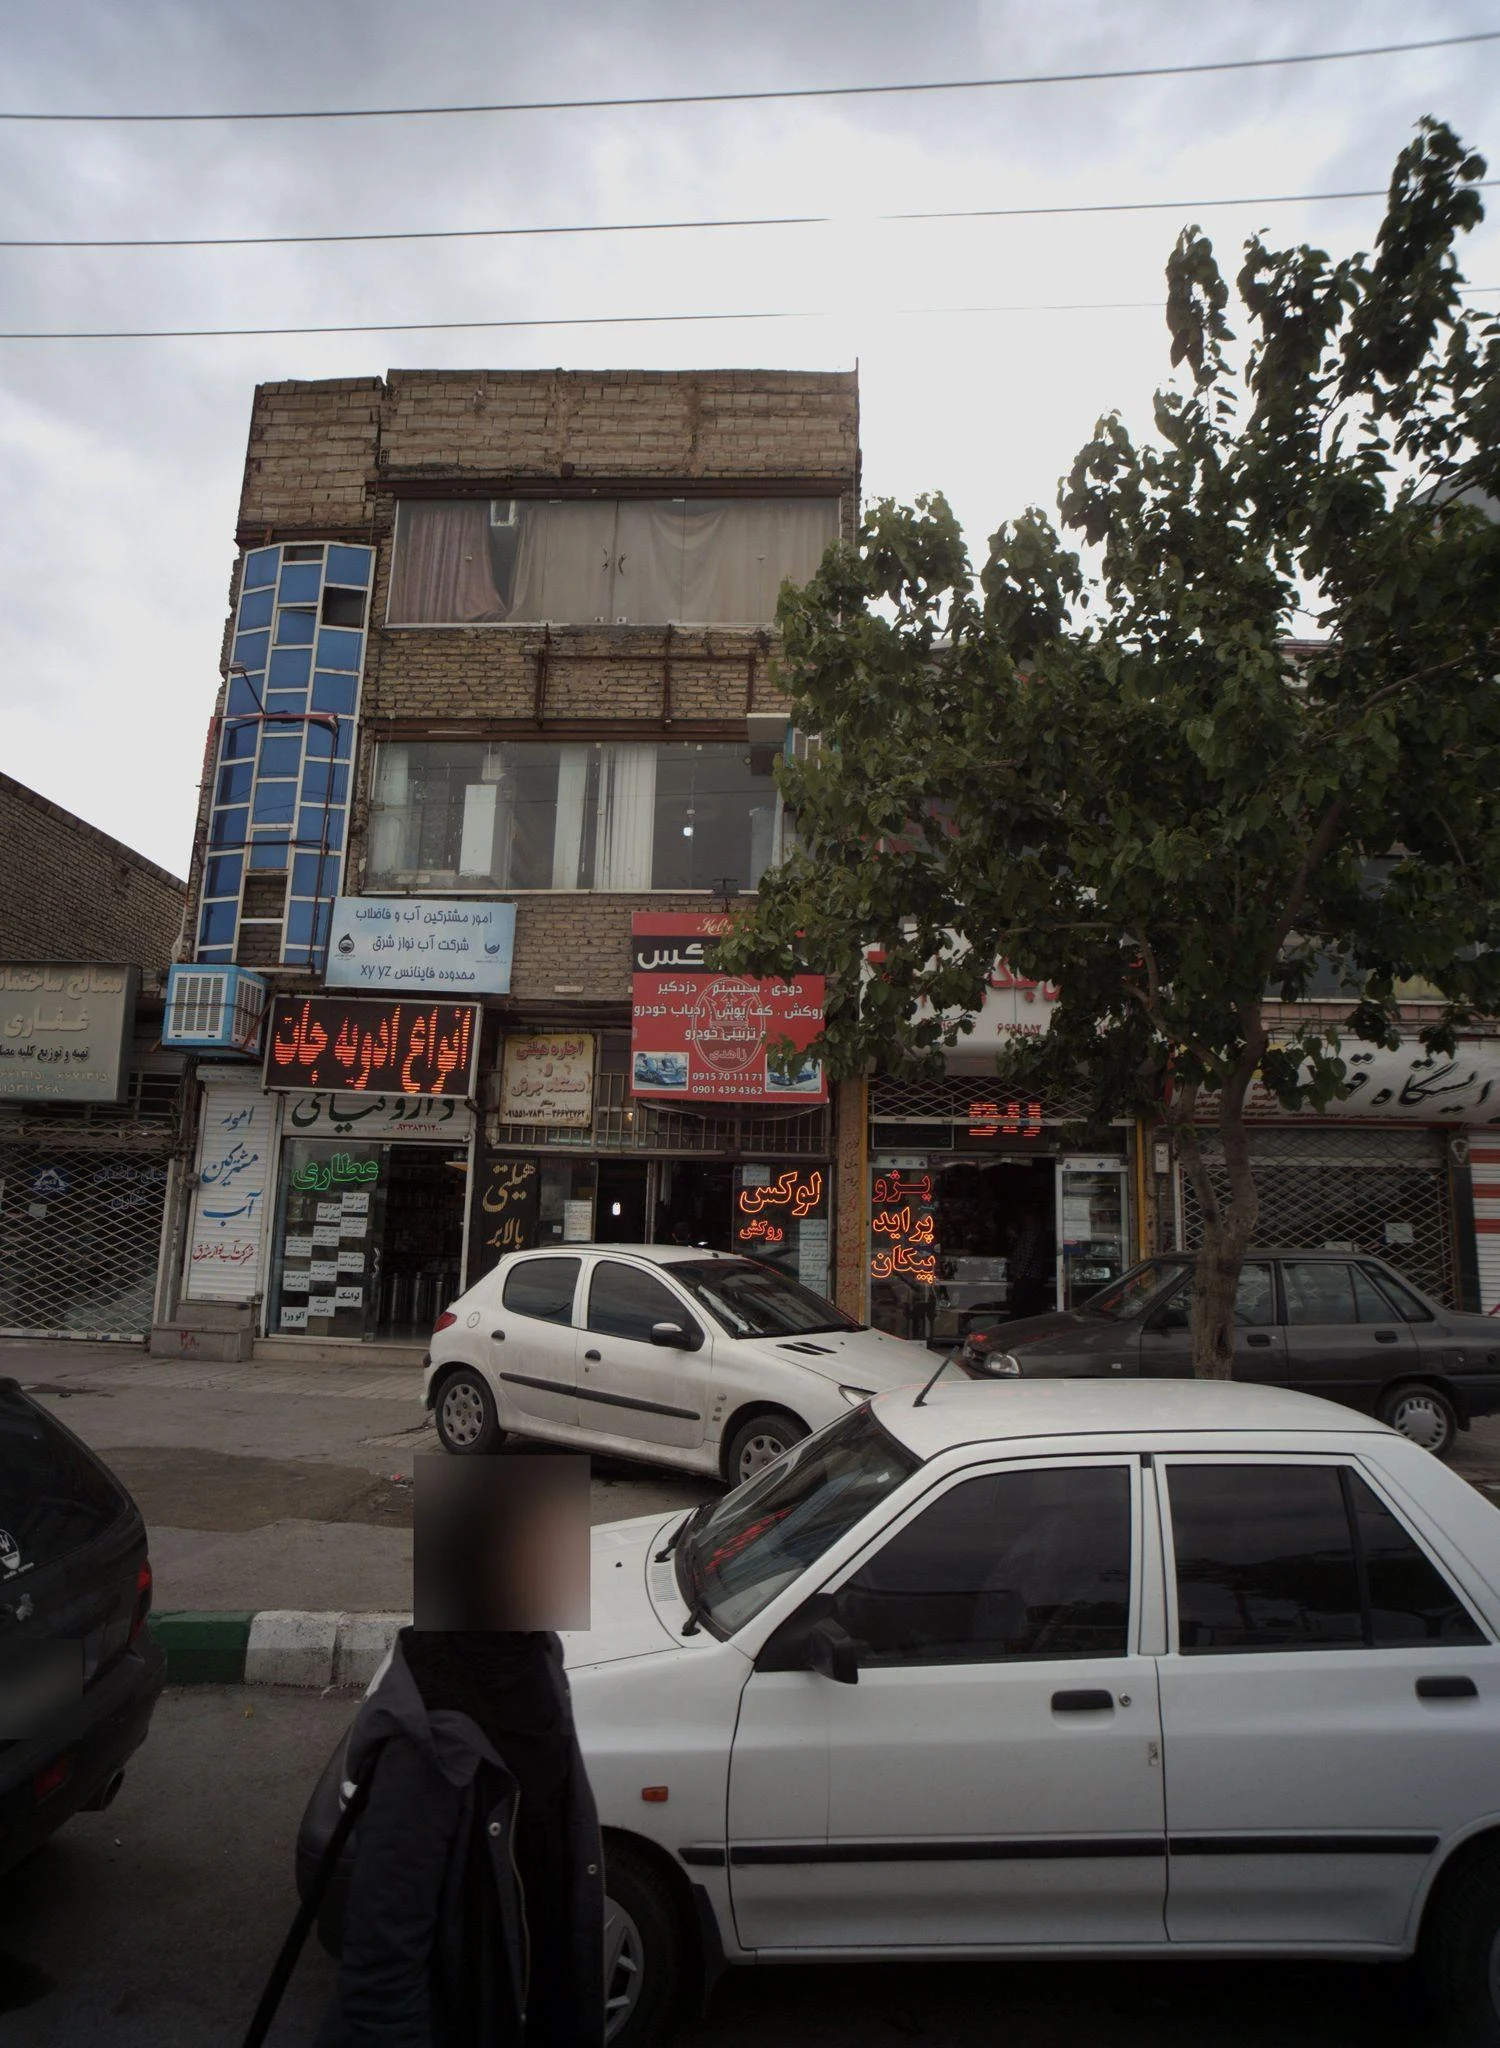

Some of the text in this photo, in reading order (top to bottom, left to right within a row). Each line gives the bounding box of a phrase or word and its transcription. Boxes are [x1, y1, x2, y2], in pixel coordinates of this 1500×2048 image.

[356, 905, 492, 926] امور مشترکین آب و فاضلاب
[372, 934, 470, 953] شرکت آب نواز شرق
[67, 966, 123, 1000] مصالح
[394, 967, 435, 982] فاینانس
[438, 968, 475, 982] محدوده
[712, 980, 761, 997] سیستم
[772, 985, 803, 997] دودی
[3, 1001, 90, 1038] غفاری
[634, 1001, 824, 1021] روکش کف پوش ردیاب خودرو
[685, 1026, 719, 1041] خودرو
[17, 1044, 36, 1062] کلیه
[37, 1045, 63, 1062] توزیع
[64, 1050, 71, 1063] و
[72, 1046, 89, 1062] تهیه
[274, 1000, 472, 1094] انواع ادویه جات
[515, 1040, 585, 1061] اجاره هیلتی
[708, 1046, 749, 1062] زاهدی
[692, 1072, 717, 1082] 0915
[718, 1073, 731, 1082] 70
[751, 1073, 763, 1082] 71
[1370, 1056, 1494, 1113] ایستگاه
[692, 1086, 763, 1096] 0901 439 4362
[220, 1105, 255, 1132] امور
[201, 1142, 259, 1187] مشترکین
[292, 1152, 380, 1191] عطاری
[482, 1162, 537, 1214] هیلتی
[739, 1170, 823, 1217] لوکس
[871, 1168, 932, 1204] پژو
[202, 1190, 264, 1227] آب
[739, 1219, 785, 1241] روکش
[872, 1206, 935, 1244] پراید
[192, 1243, 213, 1263] شرق
[231, 1243, 255, 1266] شرکت
[871, 1244, 937, 1285] پیکان
[338, 1291, 361, 1302] لواشک
